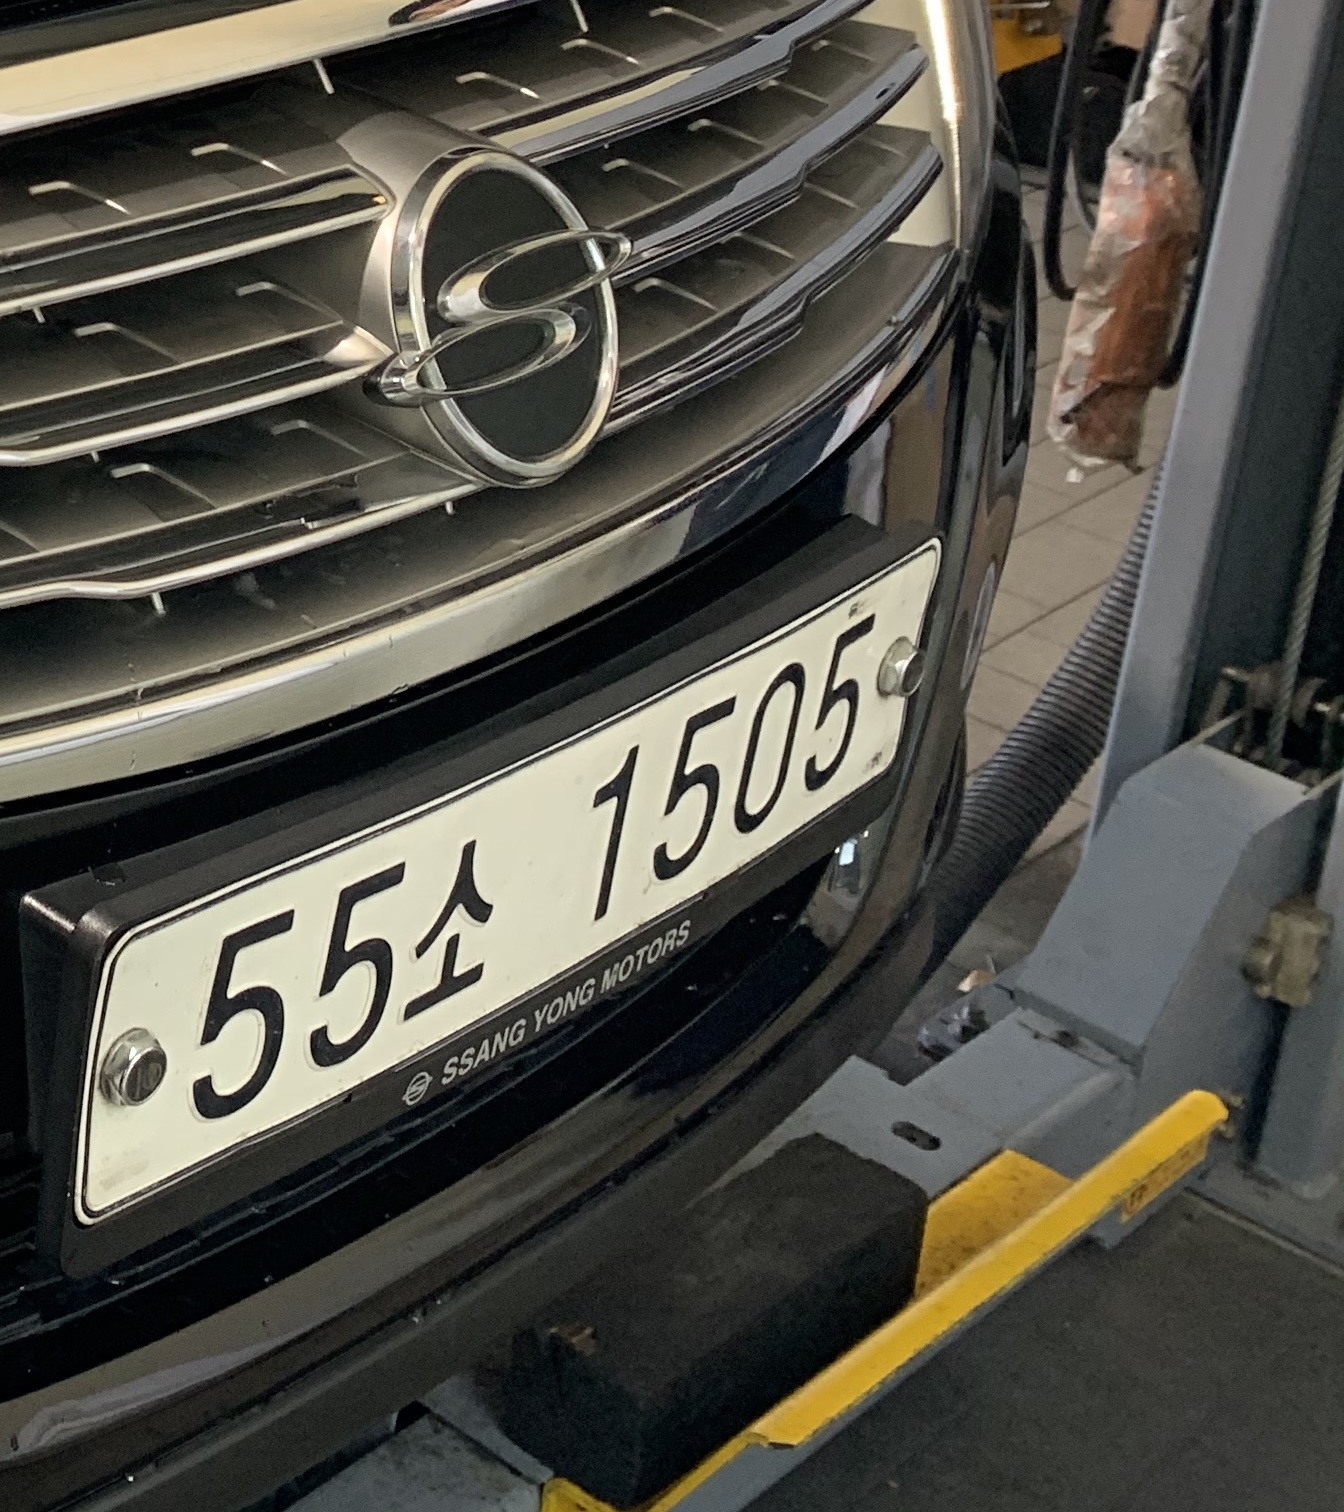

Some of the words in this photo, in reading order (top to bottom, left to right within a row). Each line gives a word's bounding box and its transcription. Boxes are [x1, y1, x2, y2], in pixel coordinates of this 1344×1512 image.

[191, 839, 494, 1121] 55소
[592, 614, 876, 922] 1505
[441, 1018, 526, 1085] SSANG
[533, 978, 597, 1033] YONG
[600, 919, 691, 993] MOTORS
